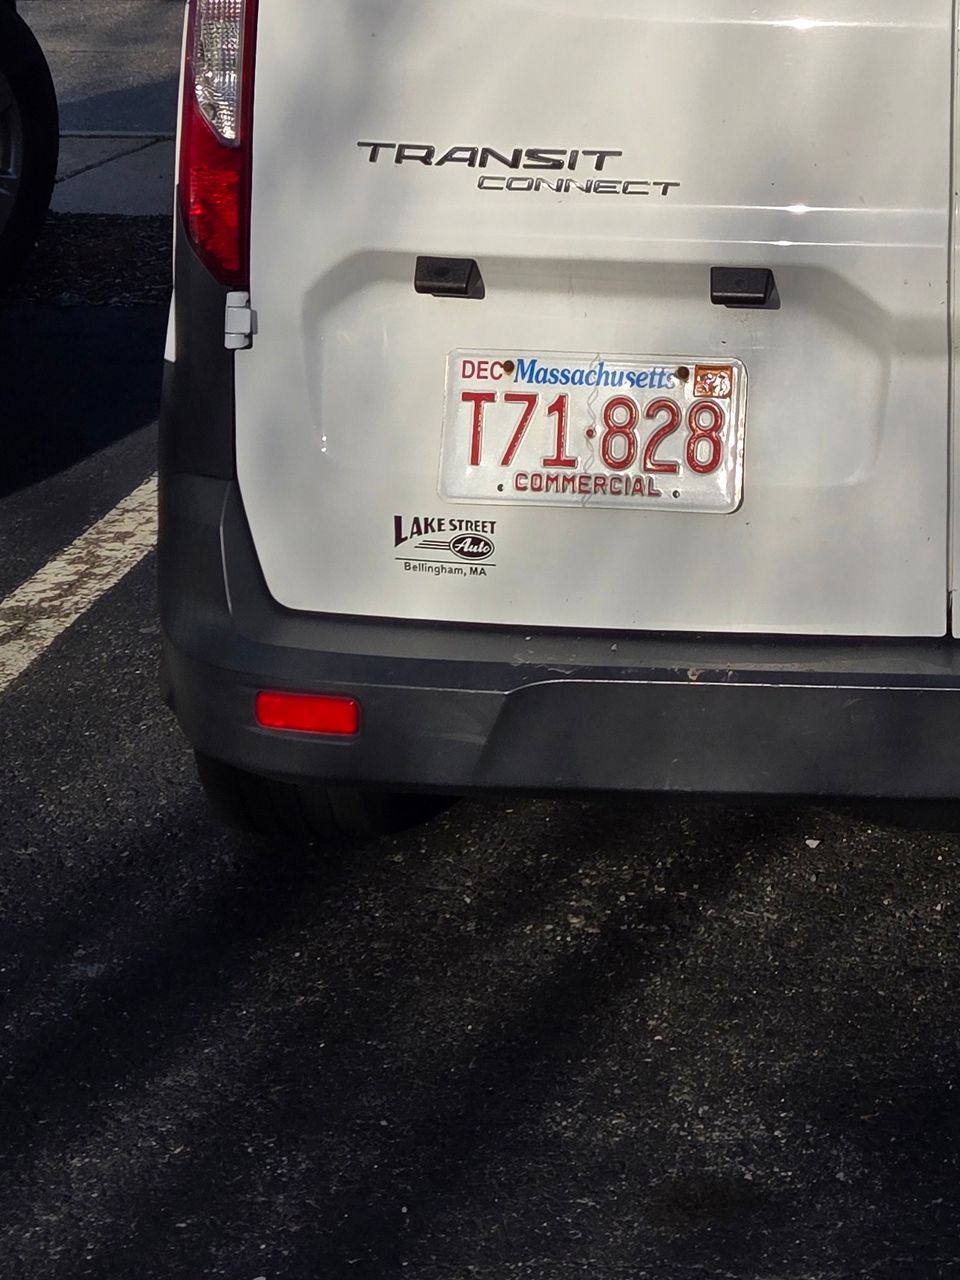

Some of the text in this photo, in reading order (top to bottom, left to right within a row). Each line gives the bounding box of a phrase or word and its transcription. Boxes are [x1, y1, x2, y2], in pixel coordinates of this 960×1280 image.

[357, 141, 623, 171] TRANSIT
[477, 175, 681, 196] CONNECT
[461, 360, 503, 380] DEC
[513, 358, 677, 389] Massachusetts
[514, 472, 662, 498] COMMERCIAL
[394, 515, 497, 548] LAKE STREET
[454, 537, 491, 554] Auto
[404, 562, 487, 577] Bellingham, MA
